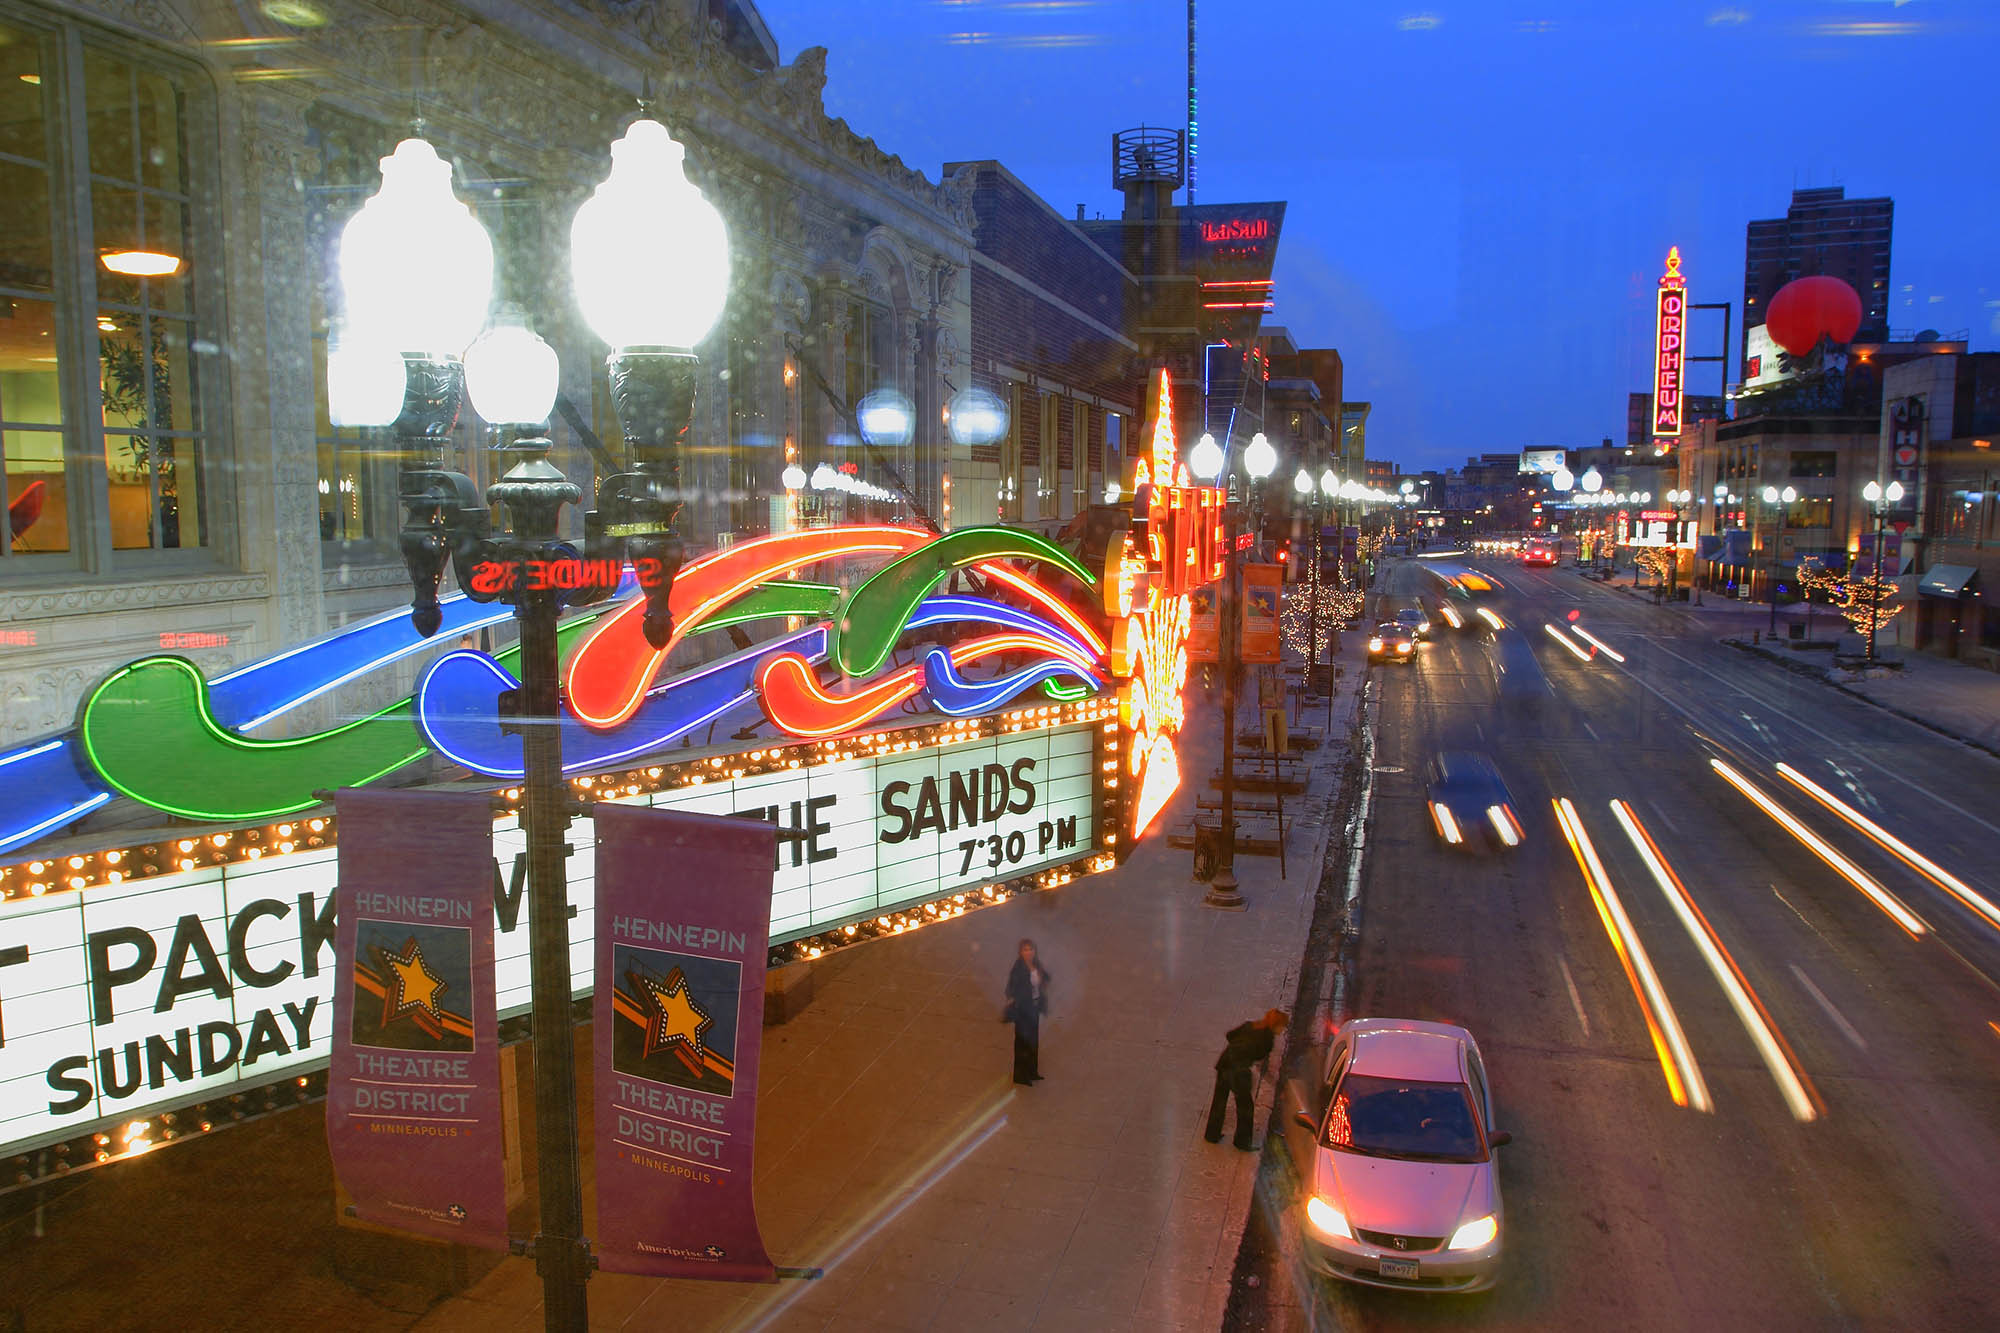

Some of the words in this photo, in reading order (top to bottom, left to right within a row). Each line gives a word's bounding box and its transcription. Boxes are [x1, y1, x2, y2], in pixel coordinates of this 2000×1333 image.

[1657, 296, 1682, 425] ORPHEUM
[725, 794, 837, 871] HE
[879, 757, 1036, 844] SANDS
[1038, 815, 1077, 855] PM
[355, 891, 472, 919] HENNEPIN
[612, 915, 746, 953] HENNEPIN
[87, 887, 339, 1026] PACK
[47, 996, 319, 1115] SUNDAY
[355, 1053, 469, 1079] THEATRE
[355, 1088, 470, 1113] DISTRICT
[617, 1080, 725, 1125] THEATRE
[370, 1123, 457, 1137] MINNEAPOLIS
[618, 1114, 724, 1160] DISTRICT
[631, 1154, 712, 1184] MINNEAPOLIS
[637, 1241, 703, 1257] Ameriprise
